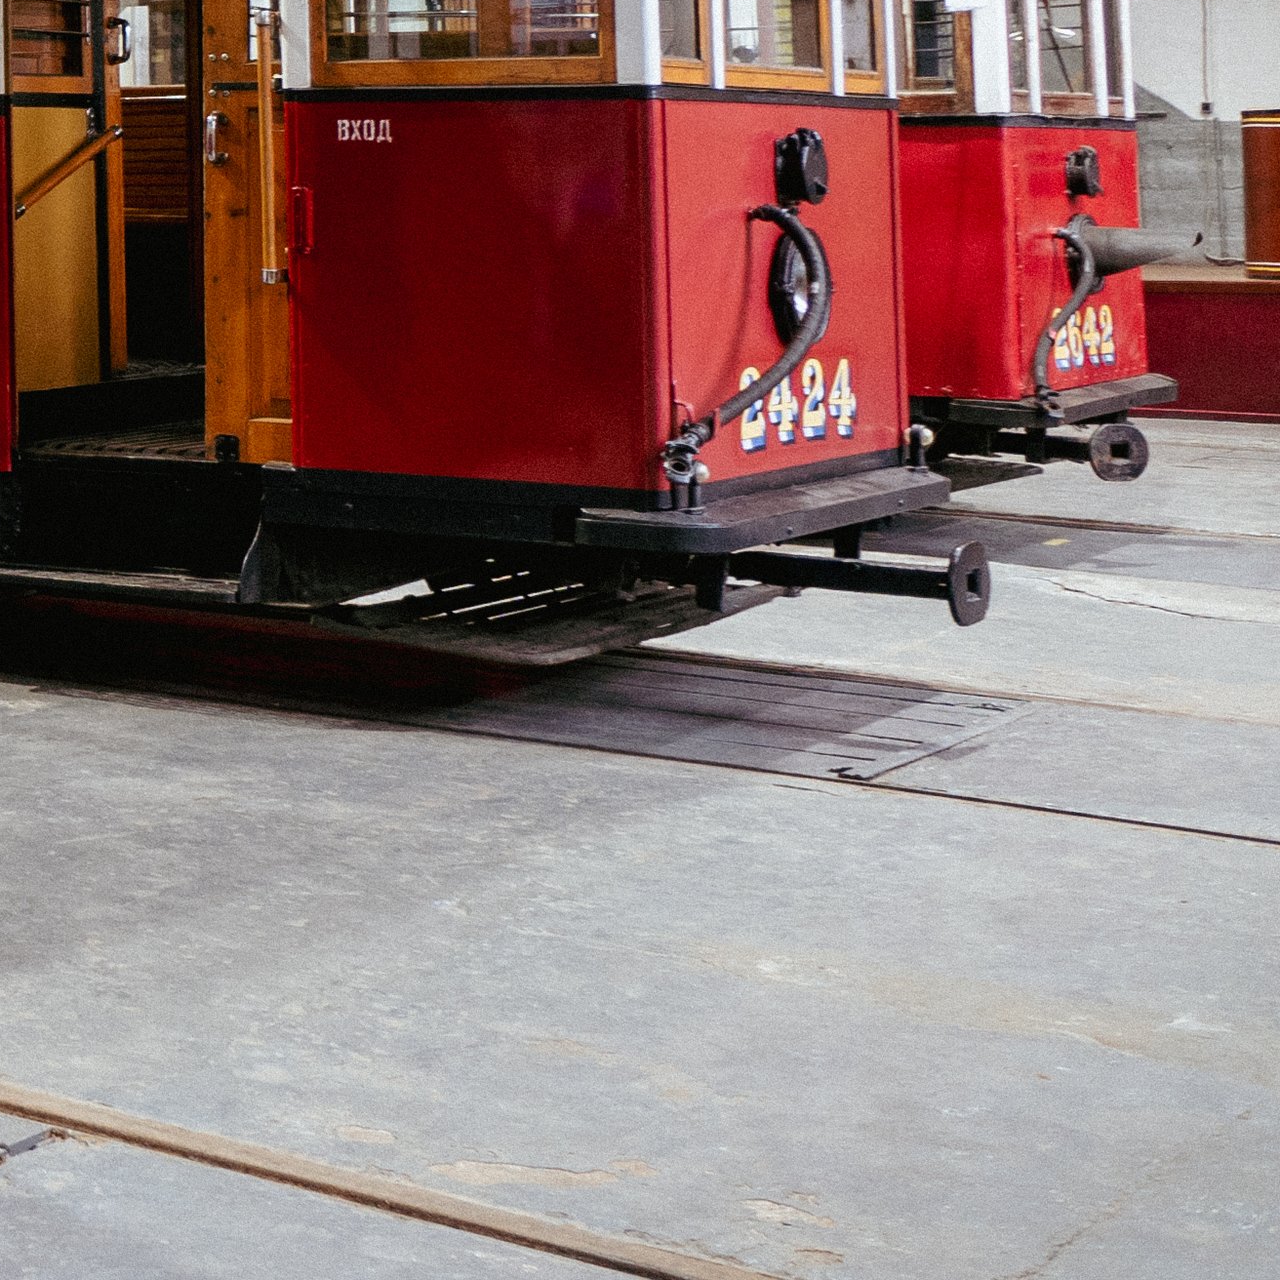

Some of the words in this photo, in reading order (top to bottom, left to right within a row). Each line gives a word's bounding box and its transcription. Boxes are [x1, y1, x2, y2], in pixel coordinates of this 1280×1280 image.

[337, 119, 393, 143] ВХОД
[1051, 303, 1116, 373] 2642
[739, 358, 857, 453] 2424
